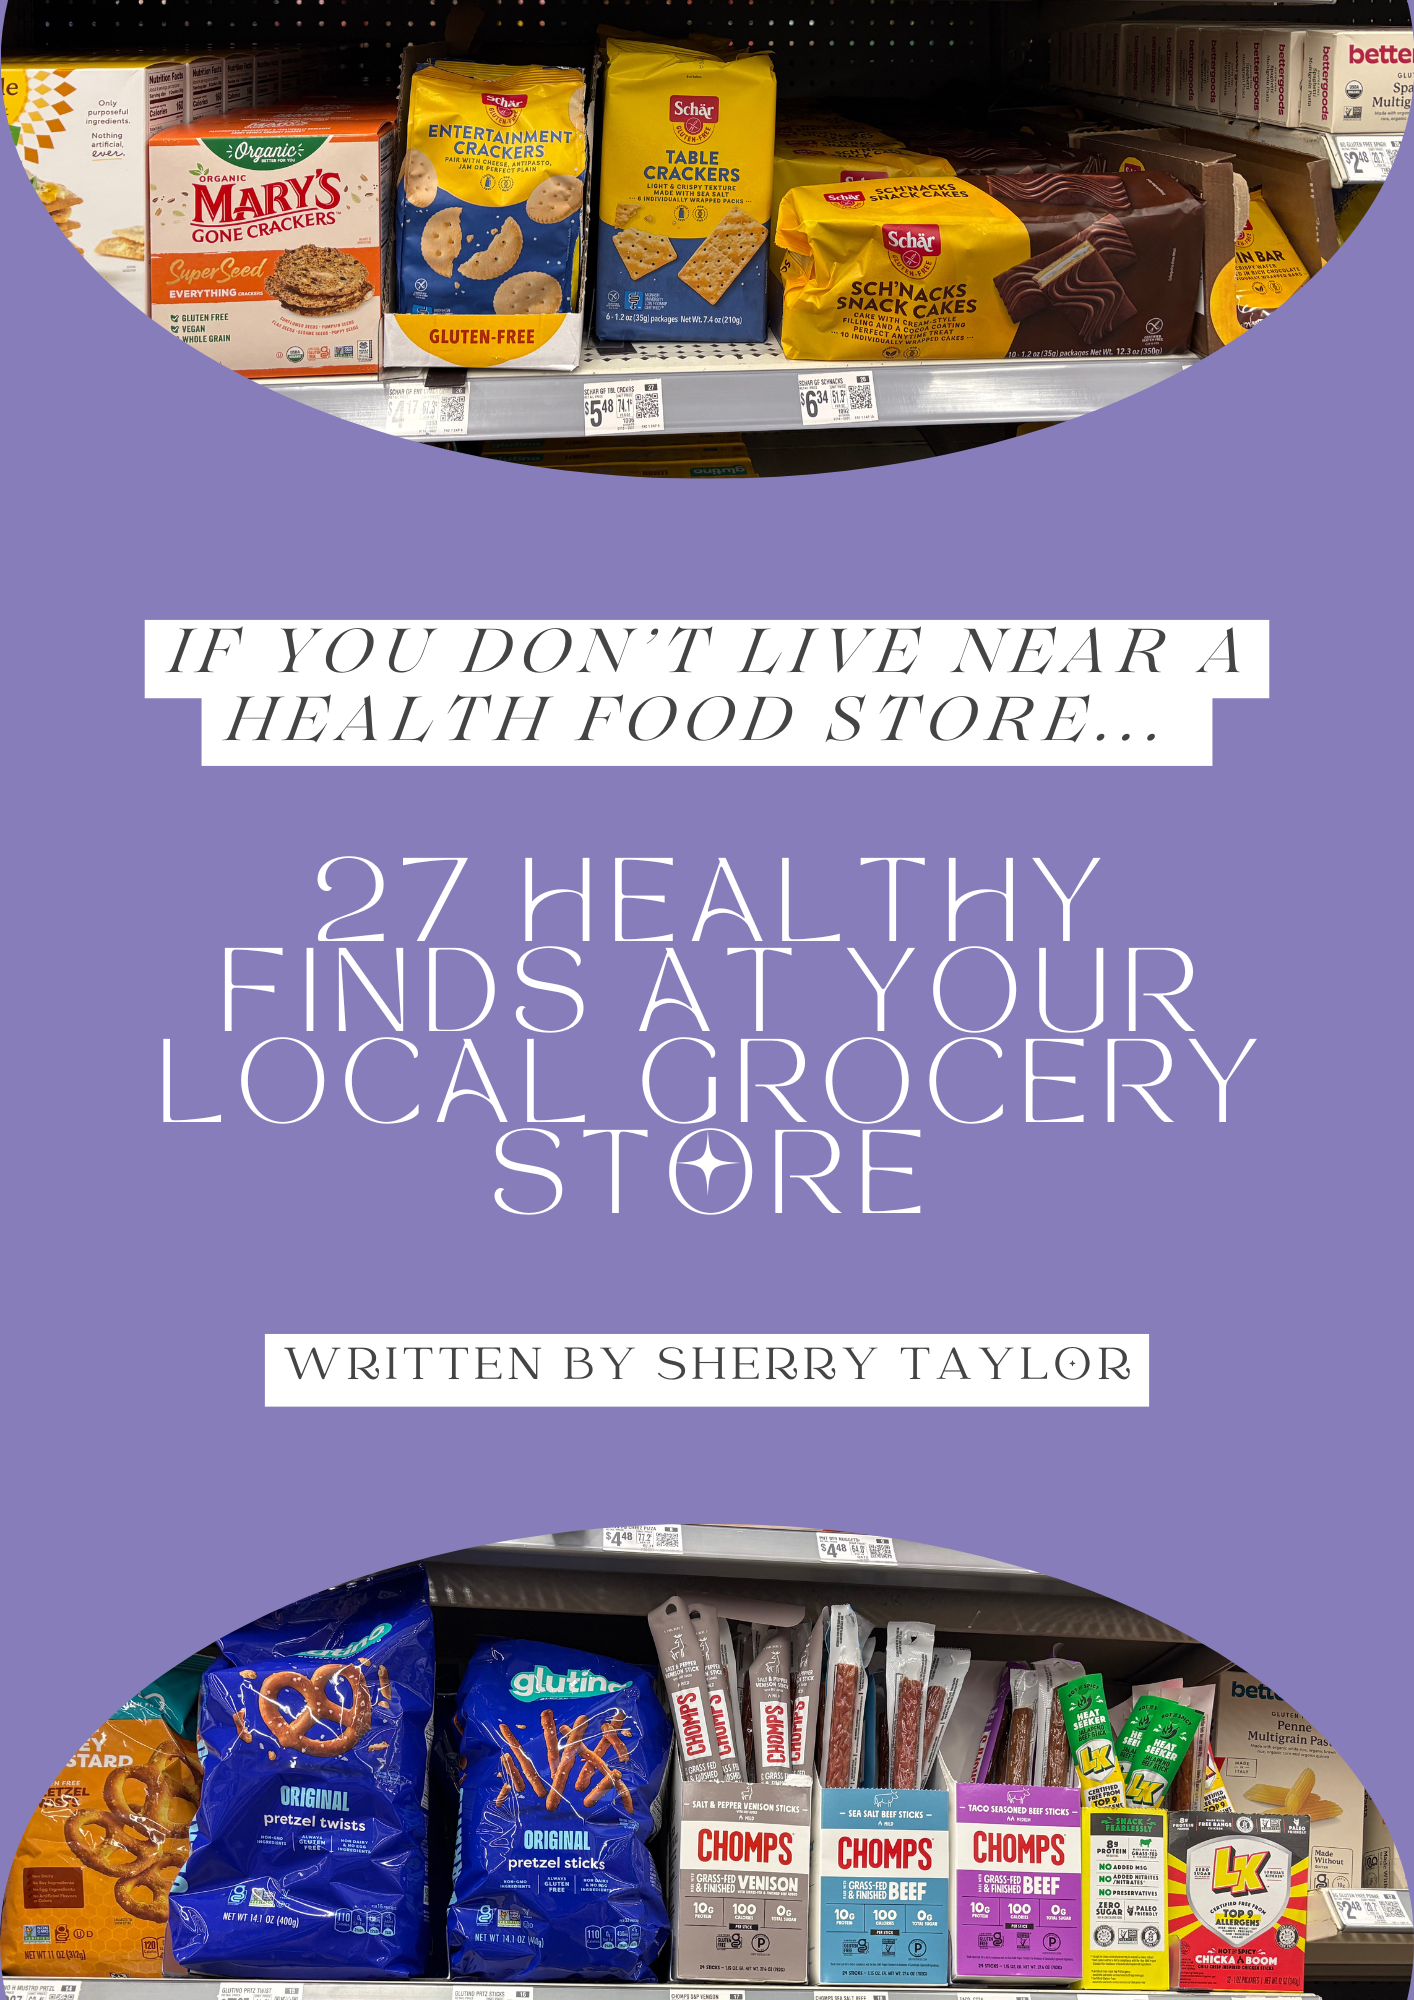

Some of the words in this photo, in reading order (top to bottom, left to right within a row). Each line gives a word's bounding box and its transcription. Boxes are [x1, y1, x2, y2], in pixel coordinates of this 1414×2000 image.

[1278, 44, 1286, 117] bettergoods
[1320, 45, 1332, 121] bettergoods
[98, 99, 117, 109] Only
[486, 94, 523, 108] Schär
[88, 109, 129, 118] purposeful
[674, 100, 715, 120] Schär
[86, 117, 131, 126] ingredients.
[92, 132, 123, 141] Nothing
[428, 124, 573, 144] ENTERTAINMENT
[675, 125, 712, 143] GLUTEN-FREE
[91, 140, 124, 149] artificial,
[453, 141, 545, 160] CRACKERS
[92, 149, 126, 158] ever.
[234, 141, 298, 164] Organic
[666, 149, 719, 165] TABLE
[482, 158, 510, 168] CHEESE,
[485, 165, 515, 173] PERFECT
[198, 174, 247, 183] ORGANIC
[643, 166, 740, 182] CRACKERS
[191, 168, 342, 224] MARY'S
[869, 192, 921, 202] SNACK
[921, 190, 969, 199] CAKES
[874, 183, 957, 195] SCH'NACKS
[192, 227, 243, 244] GONE
[887, 230, 936, 253] Schär
[1254, 250, 1286, 263] BAR
[169, 288, 237, 299] EVERYTHING
[851, 280, 967, 303] SCH'NACKS
[837, 296, 909, 317] SNACK
[912, 299, 978, 319] CAKES
[181, 313, 210, 322] GLUTEN
[210, 312, 229, 321] FREE
[614, 313, 625, 321] 1.2
[650, 314, 678, 324] packages
[680, 315, 690, 323] Net
[690, 315, 703, 323] Wt.
[703, 315, 713, 323] 7.4
[714, 316, 722, 324] oz
[721, 316, 743, 325] (210g)
[182, 325, 206, 333] VEGAN
[429, 328, 535, 344] GLUTEN-FREE
[182, 334, 208, 343] WHOLE
[208, 334, 231, 343] GRAIN
[1076, 1708, 1100, 1721] HEAT
[1271, 1711, 1299, 1719] GLUTEN
[677, 1692, 707, 1758] CHOMPS
[1073, 1715, 1107, 1731] SEEKER
[1277, 1720, 1312, 1733] Penne
[765, 1704, 787, 1764] CHOMPS
[1247, 1730, 1308, 1746] Multigrain
[1154, 1738, 1178, 1752] HEAT
[1080, 1743, 1115, 1778] LK
[1144, 1745, 1178, 1762] SEEKER
[1126, 1773, 1165, 1807] LK
[280, 1785, 350, 1812] ORIGINAL
[692, 1800, 709, 1809] SALT
[710, 1801, 716, 1809] &
[717, 1801, 742, 1810] PEPPER
[743, 1802, 774, 1812] VENISON
[775, 1804, 800, 1813] STICKS
[968, 1804, 989, 1813] TACO
[990, 1804, 1027, 1814] SEASONED
[1028, 1806, 1044, 1815] BEEF
[1044, 1807, 1070, 1816] STICKS
[848, 1809, 862, 1818] SEA
[863, 1810, 880, 1818] SALT
[881, 1810, 897, 1819] BEEF
[898, 1810, 924, 1819] STICKS
[263, 1814, 316, 1828] pretzel
[319, 1816, 366, 1832] twists
[1105, 1824, 1153, 1833] FEARLESSLY
[1115, 1817, 1143, 1826] SNACK
[298, 1838, 326, 1846] GLUTEN
[523, 1829, 591, 1851] ORIGINAL
[697, 1828, 793, 1866] CHOMPS
[837, 1836, 933, 1871] CHOMPS
[973, 1830, 1065, 1866] CHOMPS
[1314, 1849, 1334, 1858] Made
[508, 1857, 561, 1871] pretzel
[564, 1857, 606, 1870] sticks
[1098, 1863, 1112, 1871] NO
[1314, 1856, 1344, 1866] Without
[1211, 1845, 1272, 1898] LK
[737, 1874, 799, 1893] VENISON
[1022, 1875, 1061, 1895] BEEF
[888, 1882, 927, 1901] BEEF
[1098, 1888, 1112, 1896] NO
[1095, 1908, 1123, 1916] SUGAR
[1222, 1909, 1244, 1918] TOP
[1247, 1909, 1253, 1918] 9
[223, 1911, 236, 1921] NET
[237, 1912, 248, 1922] WT
[250, 1913, 262, 1924] 14.1
[265, 1914, 275, 1924] OZ
[276, 1914, 299, 1928] (400g)
[1215, 1918, 1260, 1927] ALLERGENS
[1195, 1954, 1236, 1965] CHICKA
[1245, 1955, 1278, 1966] BOOM
